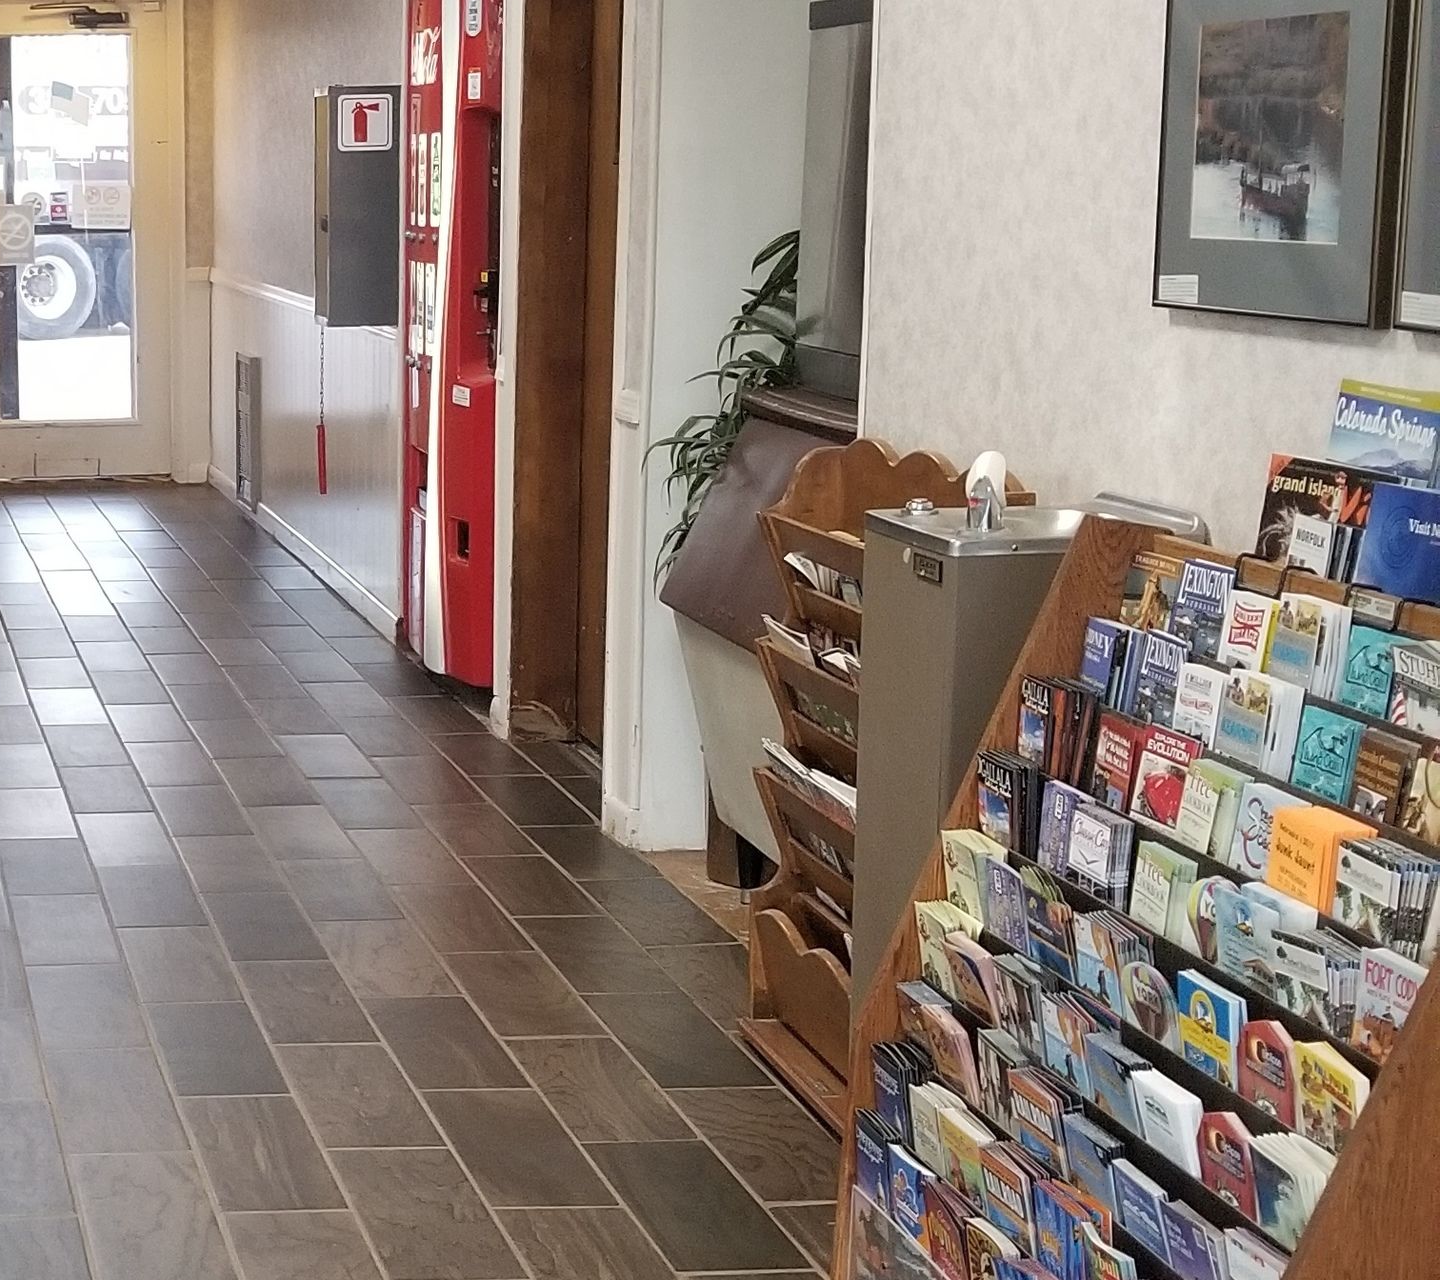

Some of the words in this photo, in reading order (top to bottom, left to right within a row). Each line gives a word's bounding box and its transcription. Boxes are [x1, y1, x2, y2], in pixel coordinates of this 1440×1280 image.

[1335, 396, 1388, 436] Colorado
[1271, 475, 1306, 493] grand
[1309, 478, 1342, 498] island
[1295, 527, 1326, 549] NORFOLK
[1409, 517, 1431, 536] Visit
[1177, 563, 1235, 613] LEXINGTON
[1147, 740, 1190, 764] EVOLUTION
[1190, 767, 1211, 799] Free
[1141, 850, 1164, 887] Free
[1365, 958, 1393, 994] FORT
